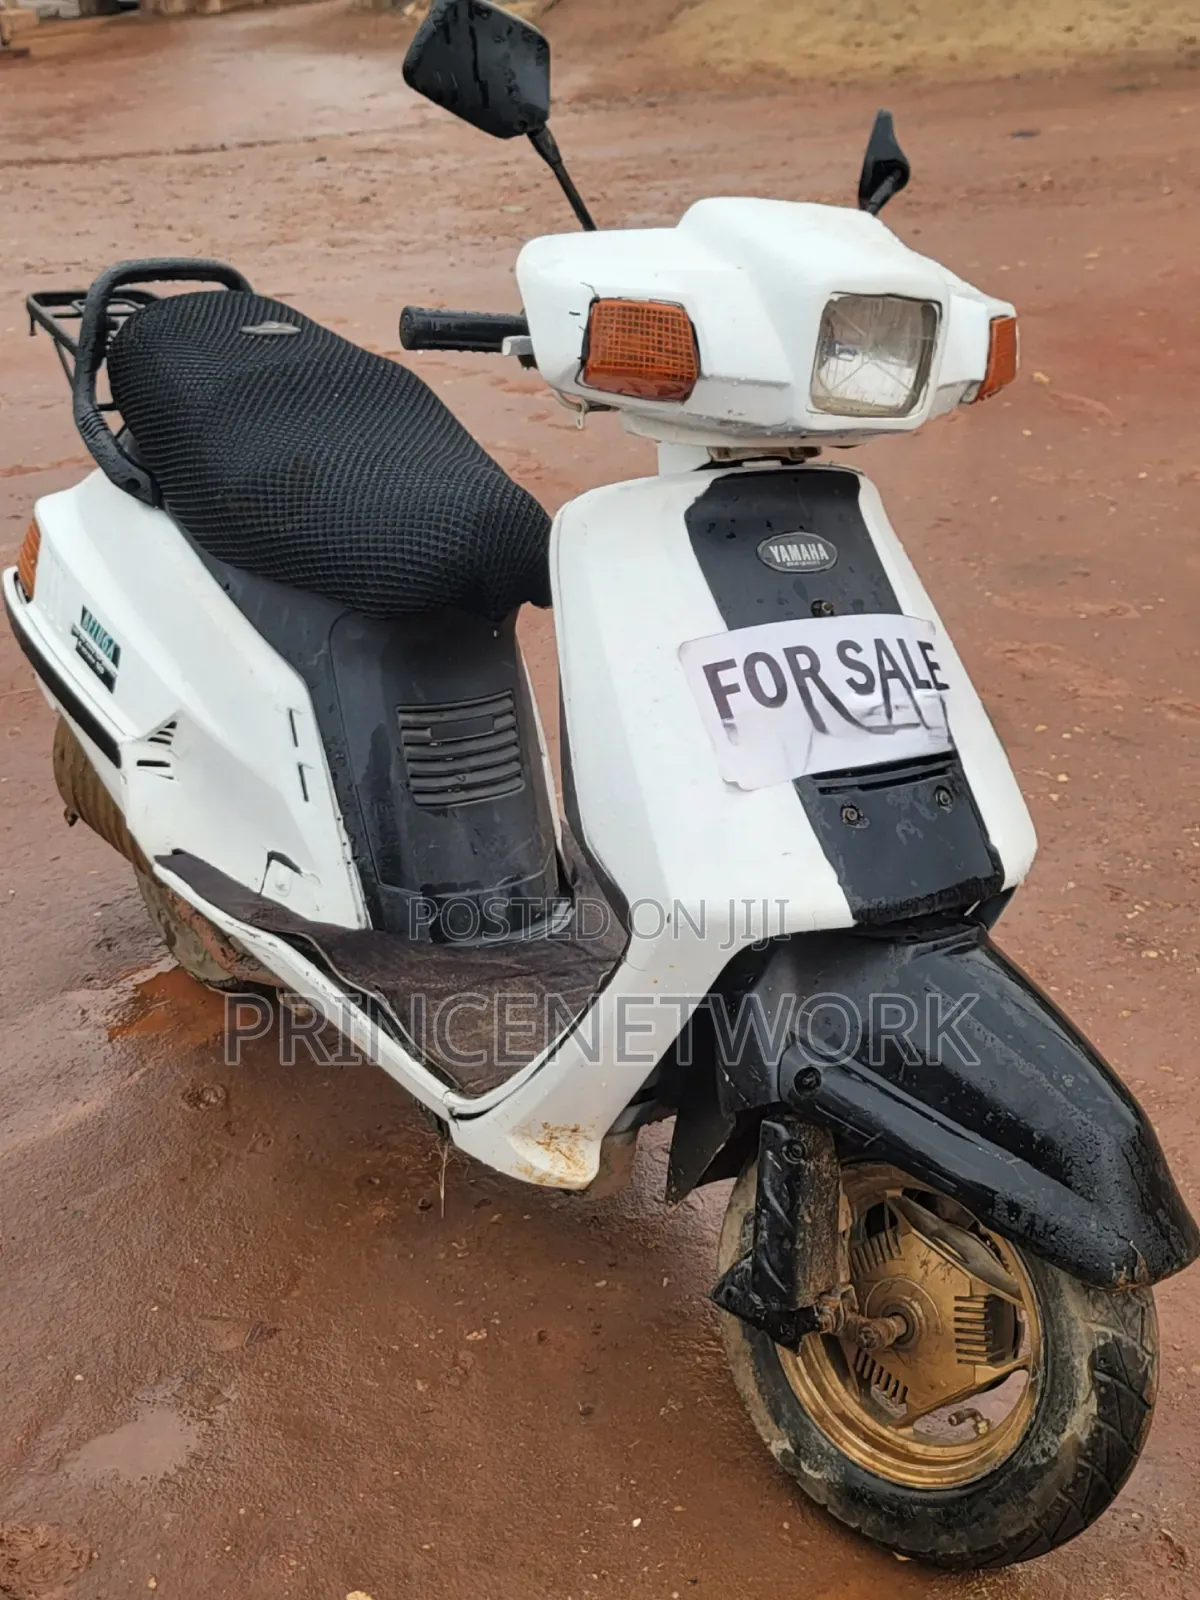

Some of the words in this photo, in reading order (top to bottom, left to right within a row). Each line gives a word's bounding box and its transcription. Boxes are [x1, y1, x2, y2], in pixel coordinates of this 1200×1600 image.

[768, 543, 829, 563] YAMAHA
[702, 645, 842, 735] FOR
[836, 638, 950, 728] SALE
